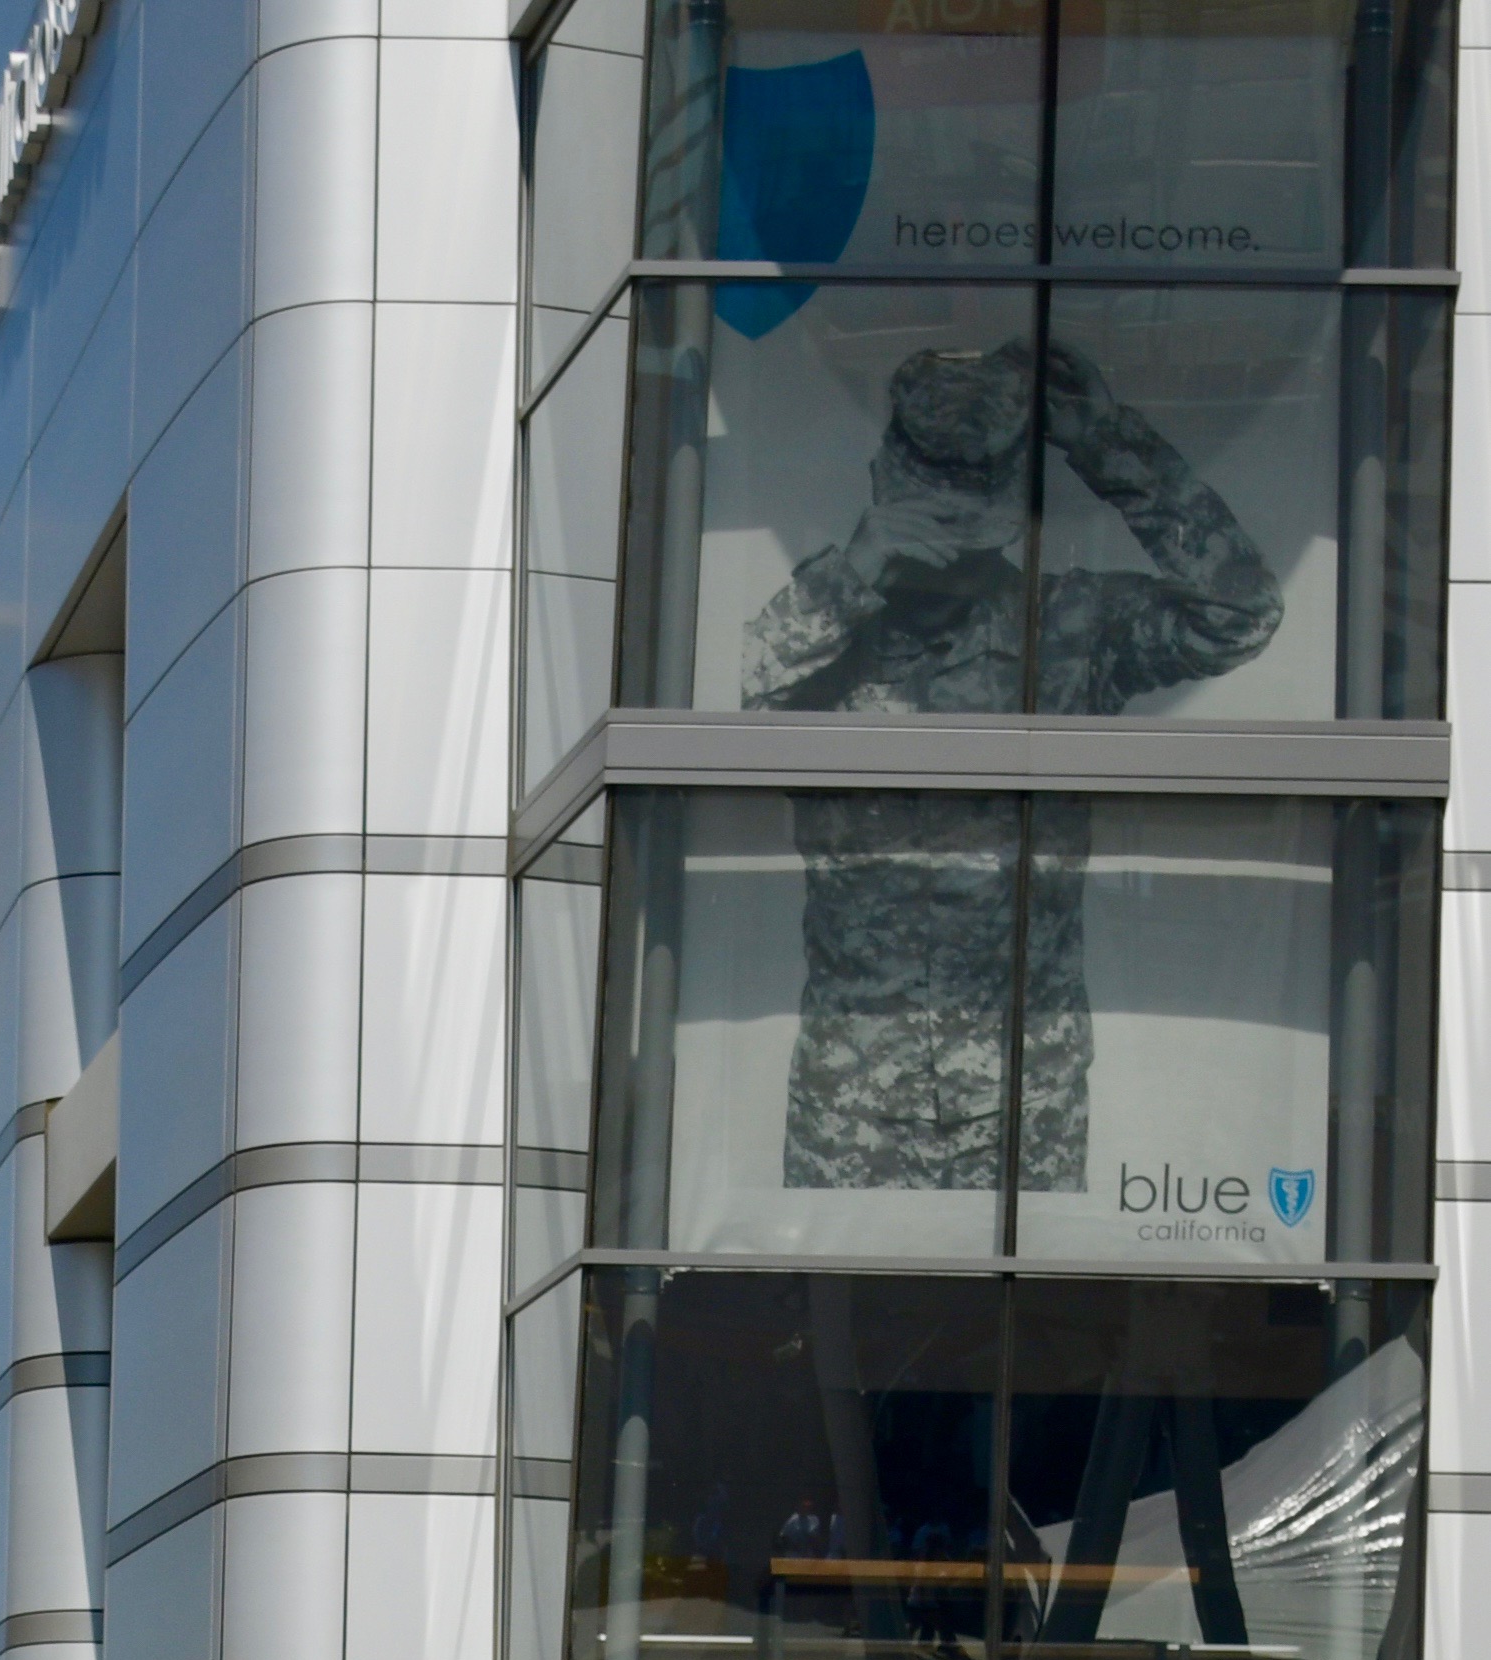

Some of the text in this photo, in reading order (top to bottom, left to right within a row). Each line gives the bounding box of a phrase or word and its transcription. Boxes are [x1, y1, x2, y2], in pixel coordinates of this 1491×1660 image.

[1056, 217, 1261, 254] welcome.
[1118, 1163, 1251, 1214] blue
[1137, 1219, 1266, 1244] california
